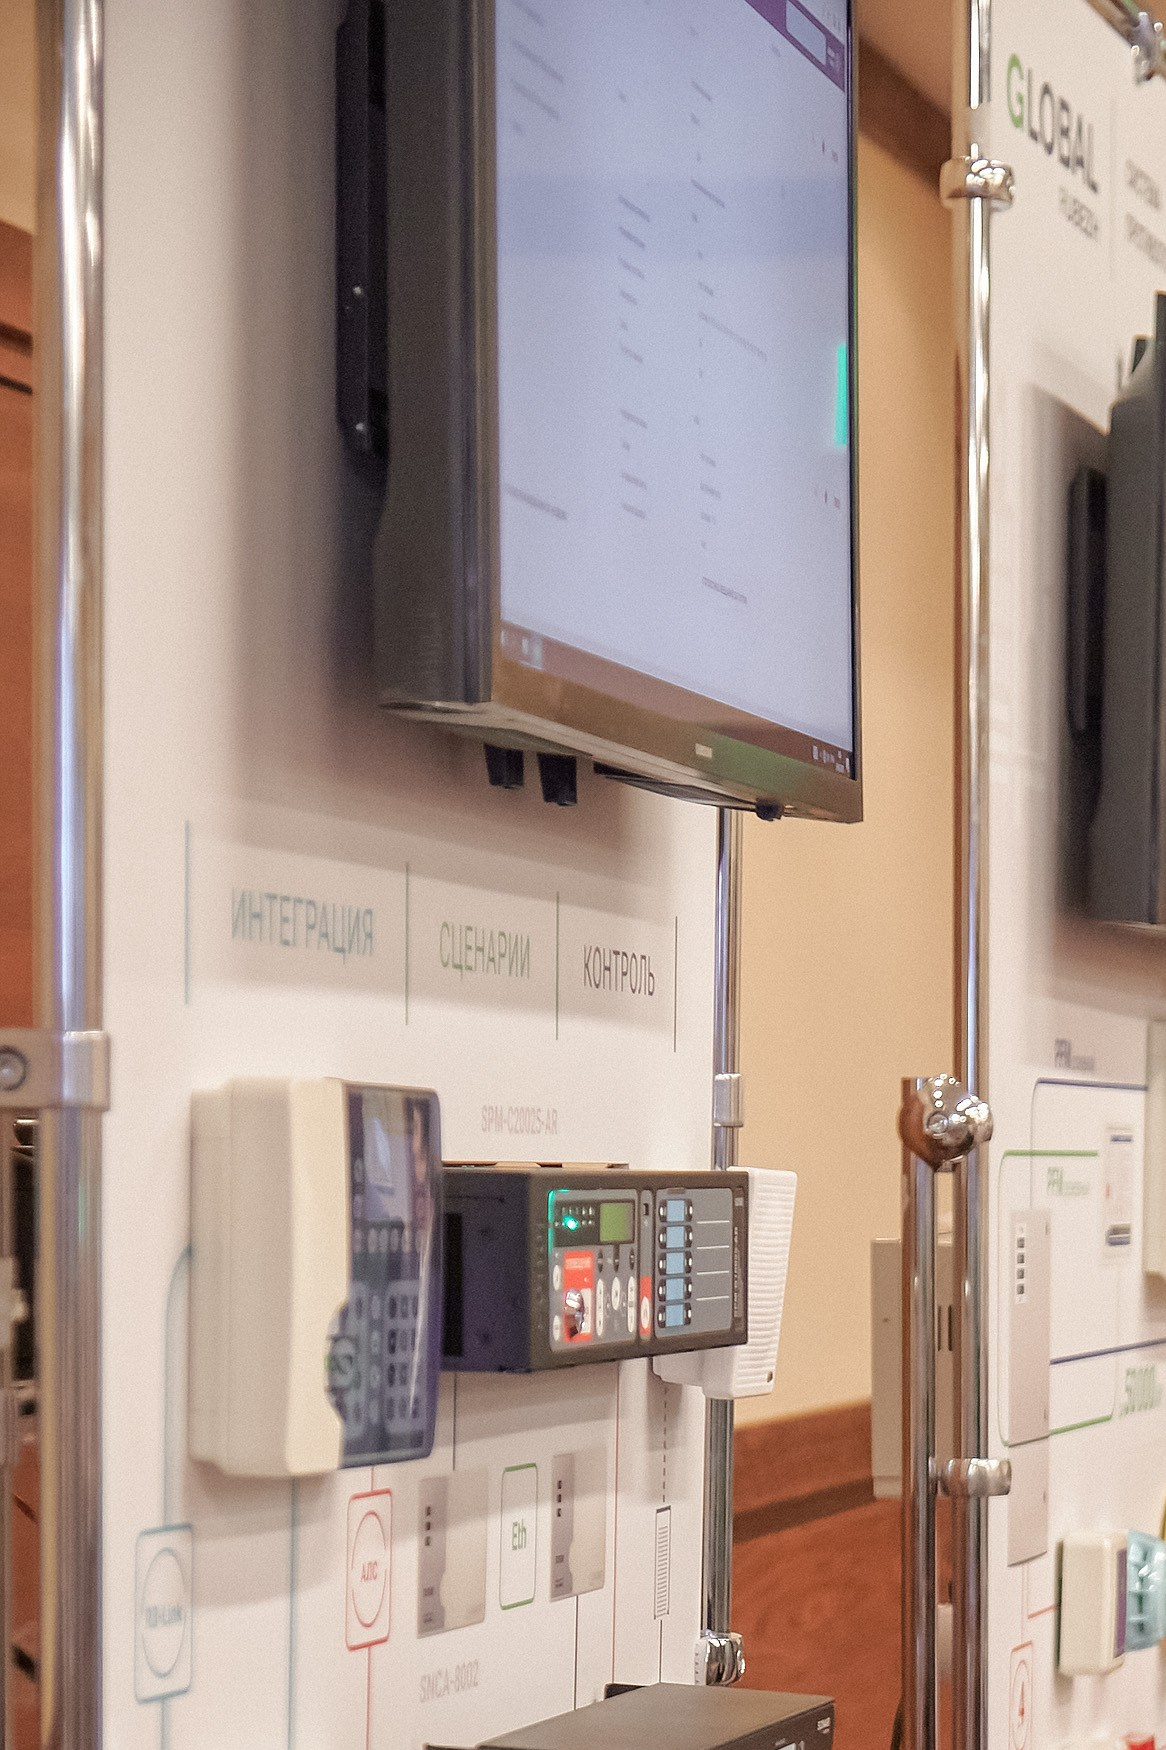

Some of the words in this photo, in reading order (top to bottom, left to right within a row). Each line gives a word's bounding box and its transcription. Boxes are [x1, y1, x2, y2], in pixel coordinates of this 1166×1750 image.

[1006, 53, 1098, 193] GLOBAL
[232, 887, 375, 962] ИНТЕГРАЦИЯ
[439, 920, 531, 981] СЦЕНАРИИ
[582, 944, 656, 997] КОНТРОЛЬ
[511, 1521, 527, 1551] Eth
[359, 1560, 378, 1583] АЛС
